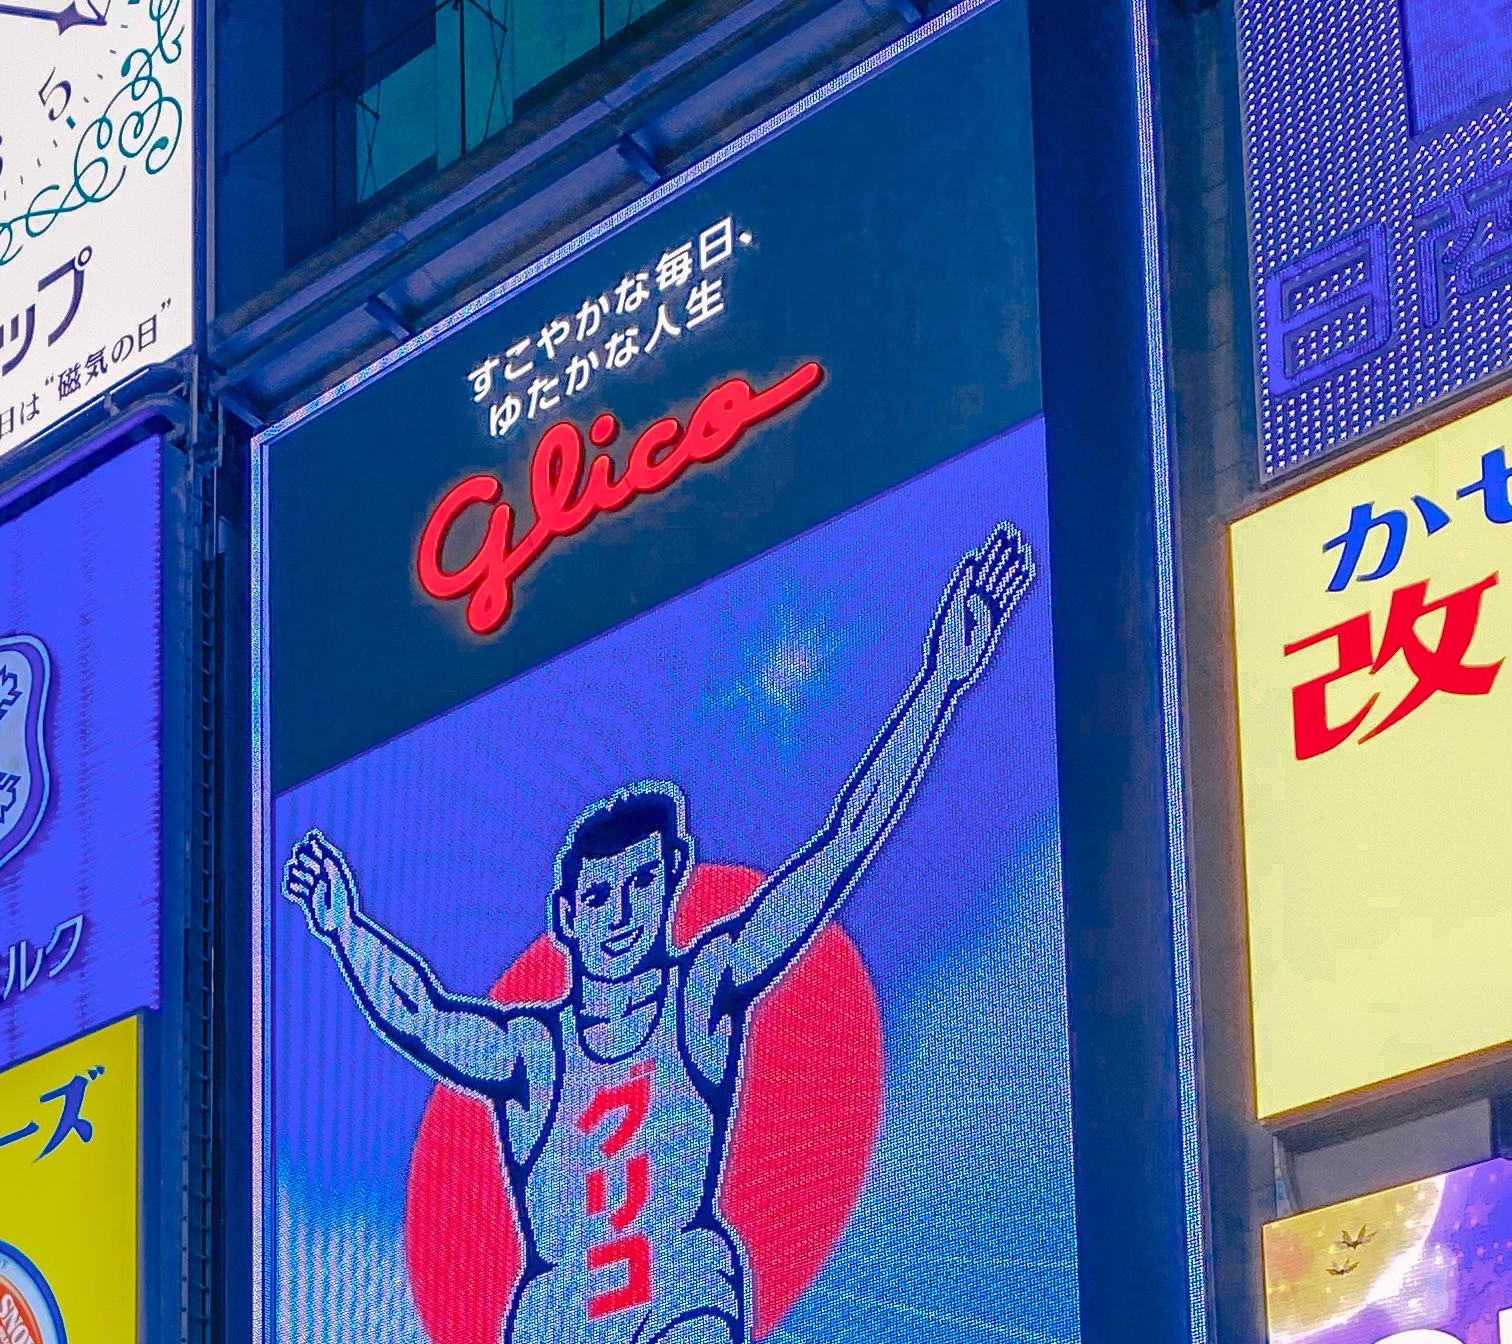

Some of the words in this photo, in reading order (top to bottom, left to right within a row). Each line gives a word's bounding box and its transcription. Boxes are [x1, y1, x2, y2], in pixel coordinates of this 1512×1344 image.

[38, 67, 72, 121] 5
[467, 216, 753, 403] すこやかな毎日、
[489, 278, 725, 438] ゆたかな人生
[1283, 570, 1506, 761] 改
[578, 1059, 655, 1322] グリコ
